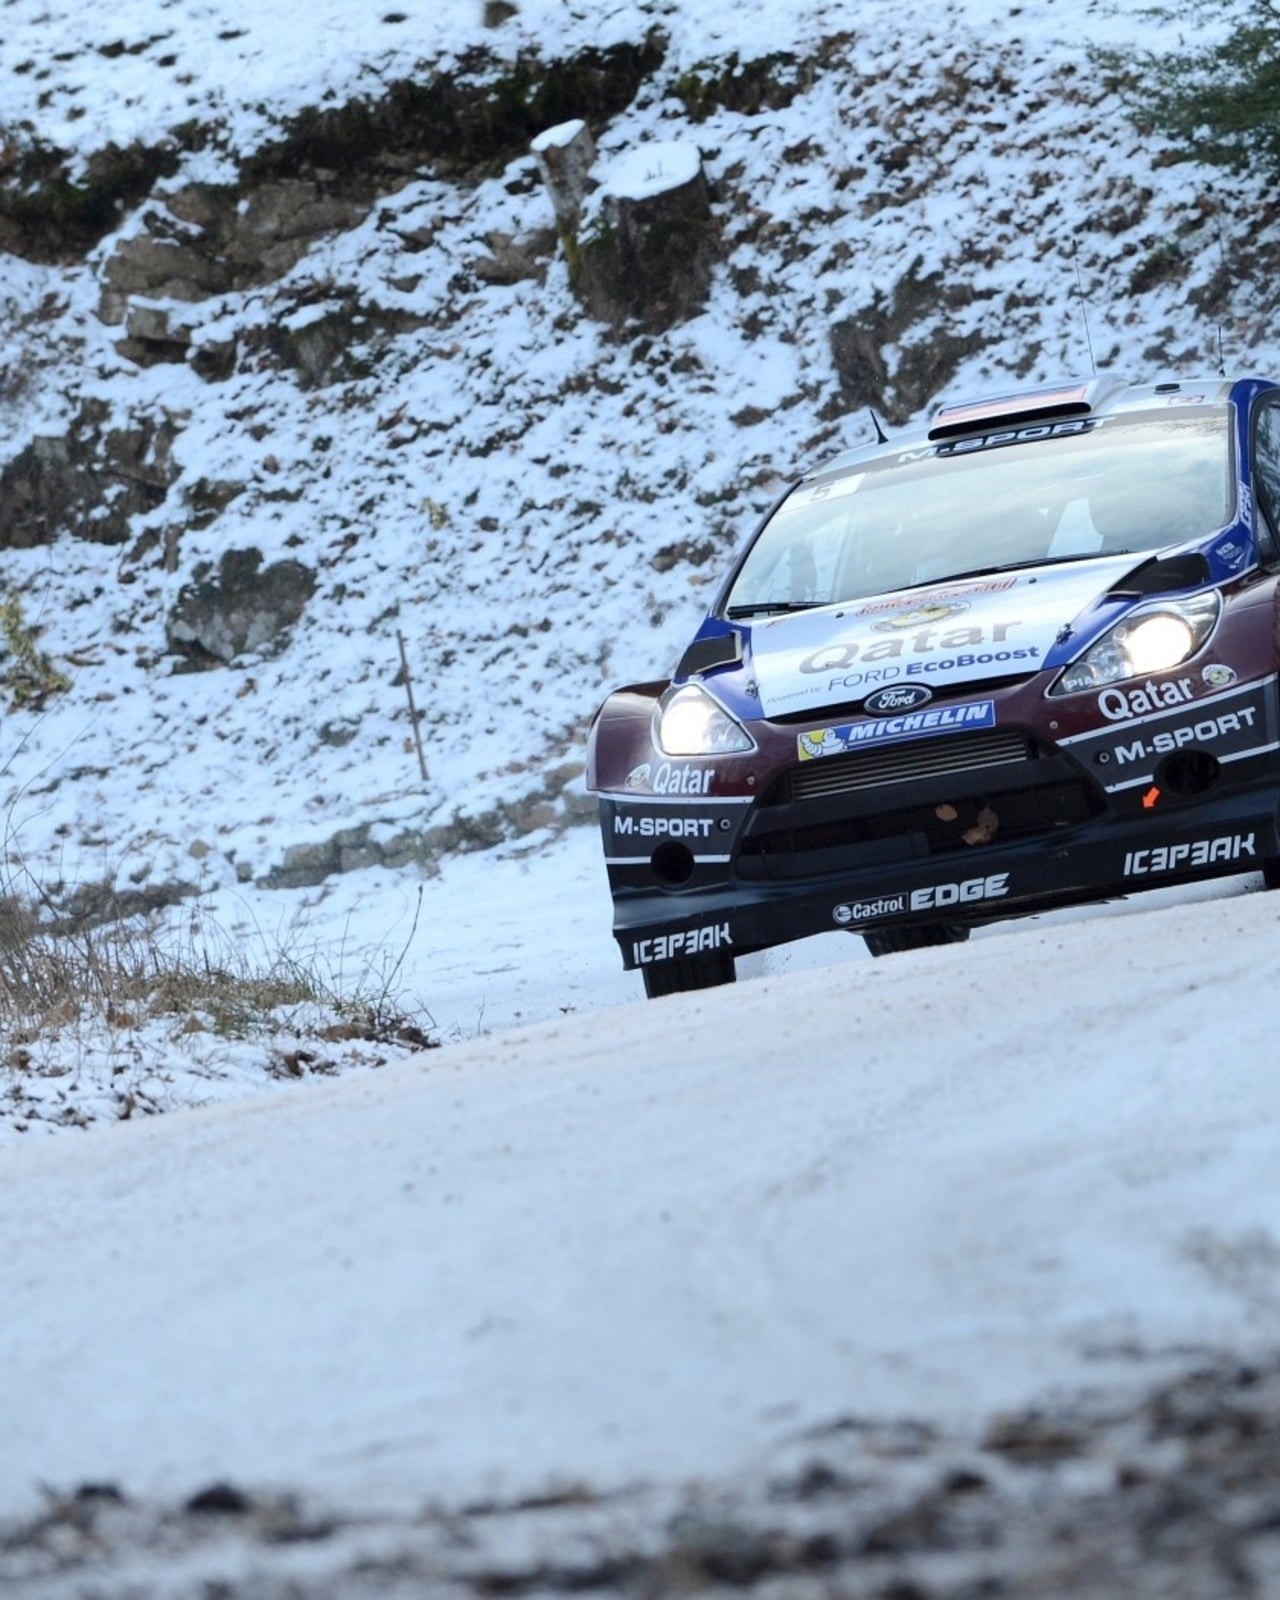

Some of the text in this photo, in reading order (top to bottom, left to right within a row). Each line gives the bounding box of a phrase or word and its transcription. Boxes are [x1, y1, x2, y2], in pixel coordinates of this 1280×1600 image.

[809, 479, 835, 502] 5
[799, 619, 1023, 674] Qatar
[828, 646, 1039, 691] FORD EcoBoost
[878, 688, 916, 708] Ford
[1099, 676, 1195, 720] Qatar
[848, 704, 990, 741] MICHELIN
[653, 763, 715, 794] Qatar
[852, 872, 1010, 920] Castrol EDGE
